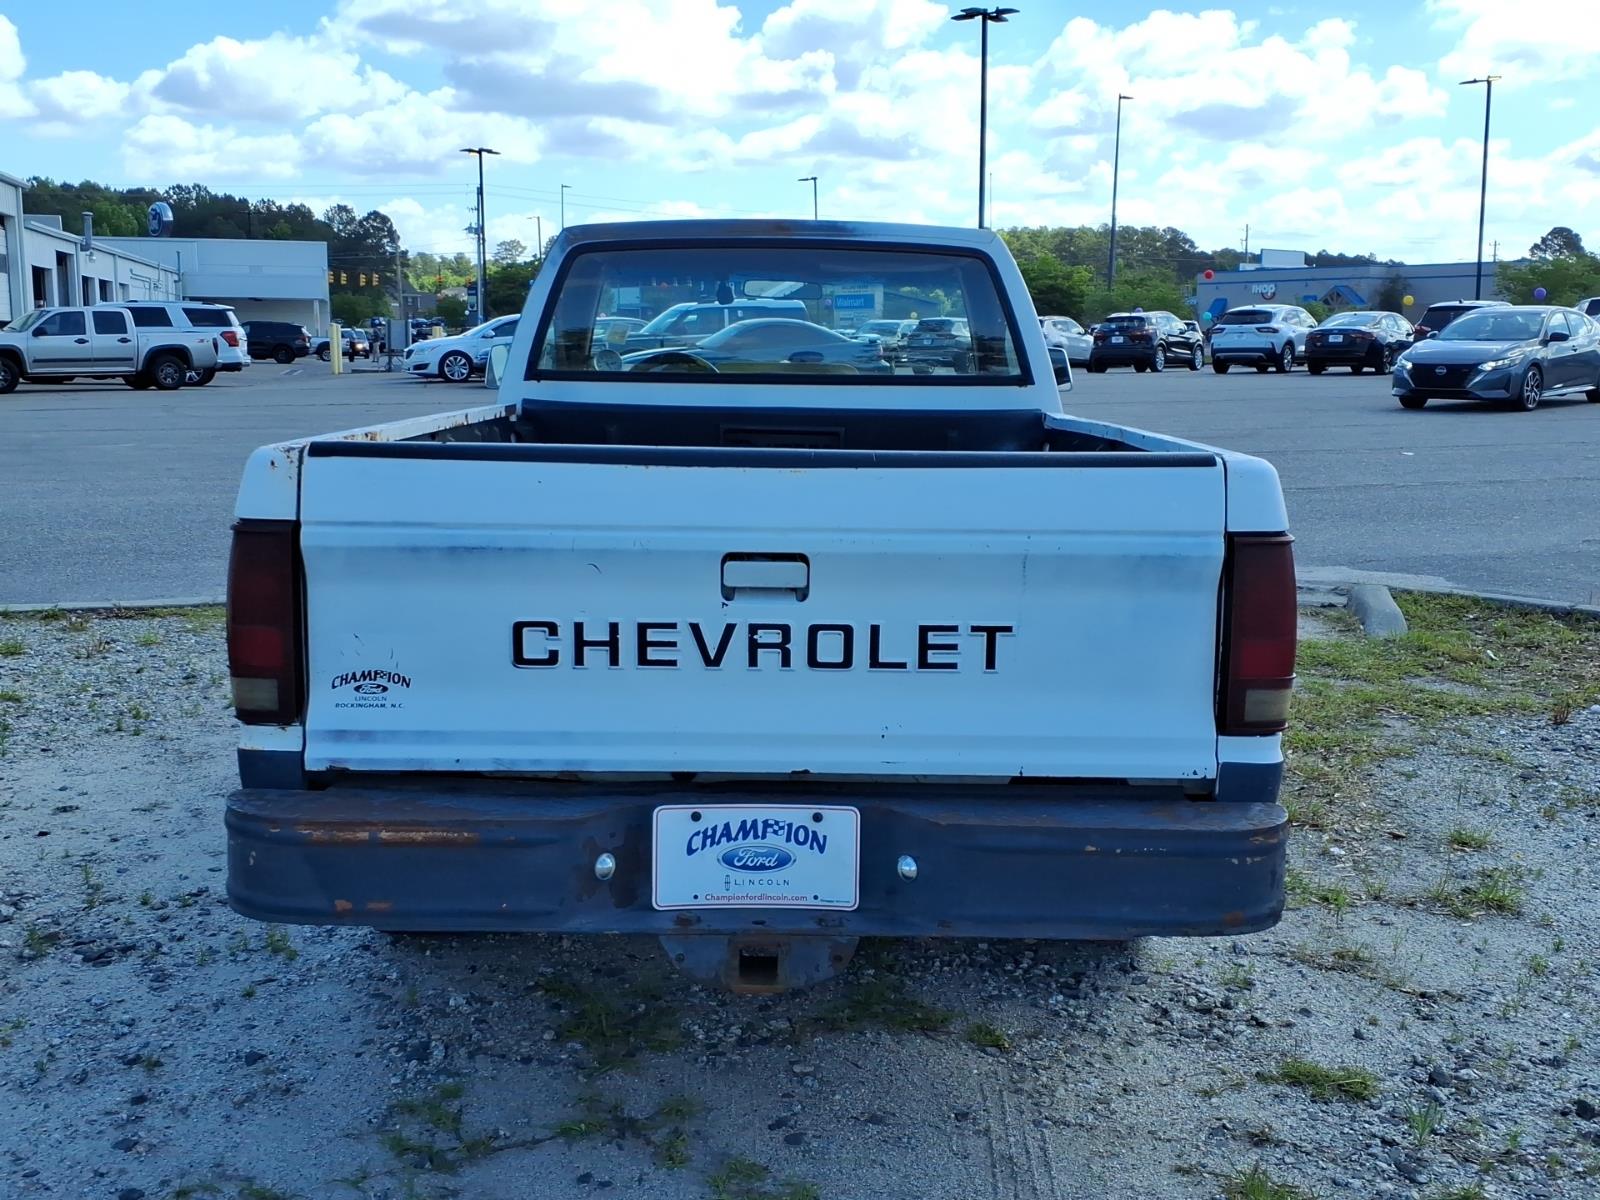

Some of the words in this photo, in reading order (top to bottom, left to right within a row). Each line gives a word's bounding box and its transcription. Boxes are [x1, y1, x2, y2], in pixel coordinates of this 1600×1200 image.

[512, 619, 1014, 671] CHEVROLET
[331, 669, 411, 689] CHAMPION
[686, 818, 828, 856] CHAMPION
[733, 849, 778, 867] Ford
[734, 878, 790, 886] LINCOLN
[704, 893, 808, 902] Championfordlincoln.com
